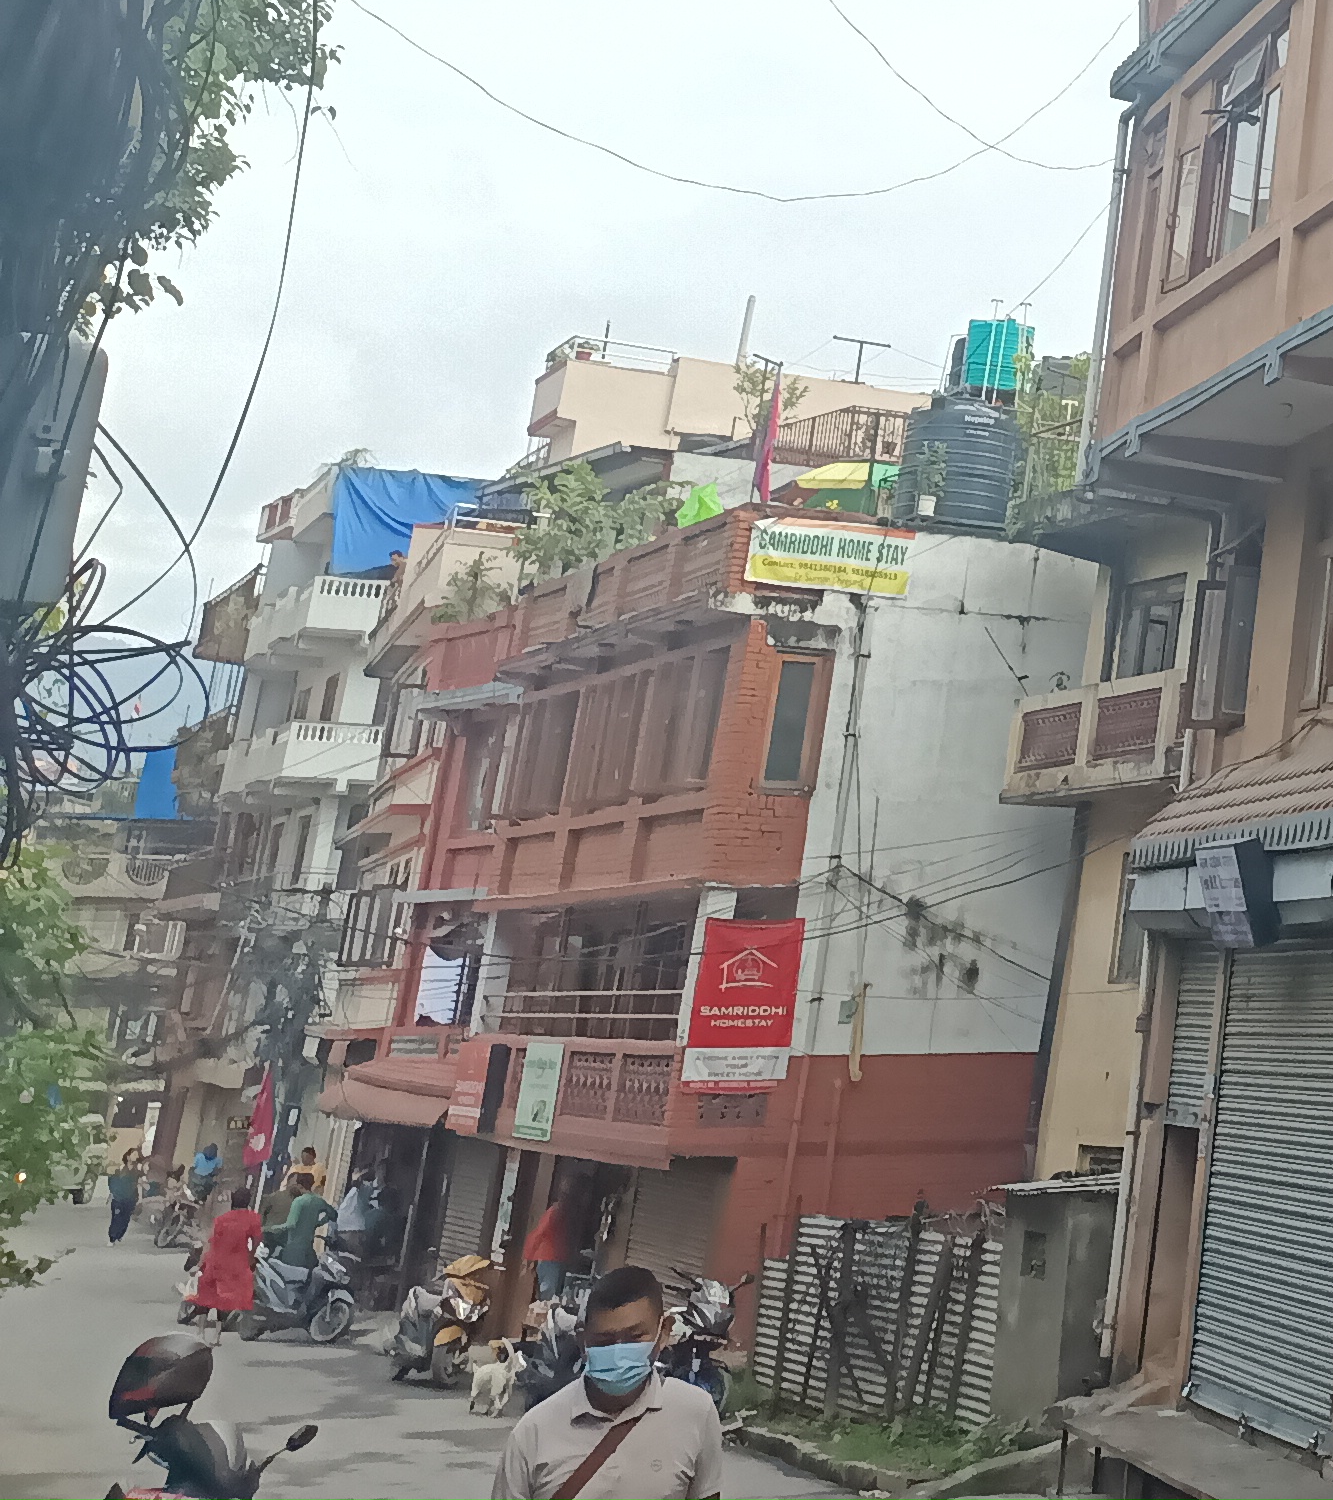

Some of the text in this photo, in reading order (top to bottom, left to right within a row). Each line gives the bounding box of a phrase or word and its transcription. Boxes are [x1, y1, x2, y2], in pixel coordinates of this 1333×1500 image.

[758, 528, 909, 567] SAMRIDDHI HOME STAY
[699, 1005, 787, 1016] SAMRIDDHI
[710, 1019, 774, 1027] HOMESTAY
